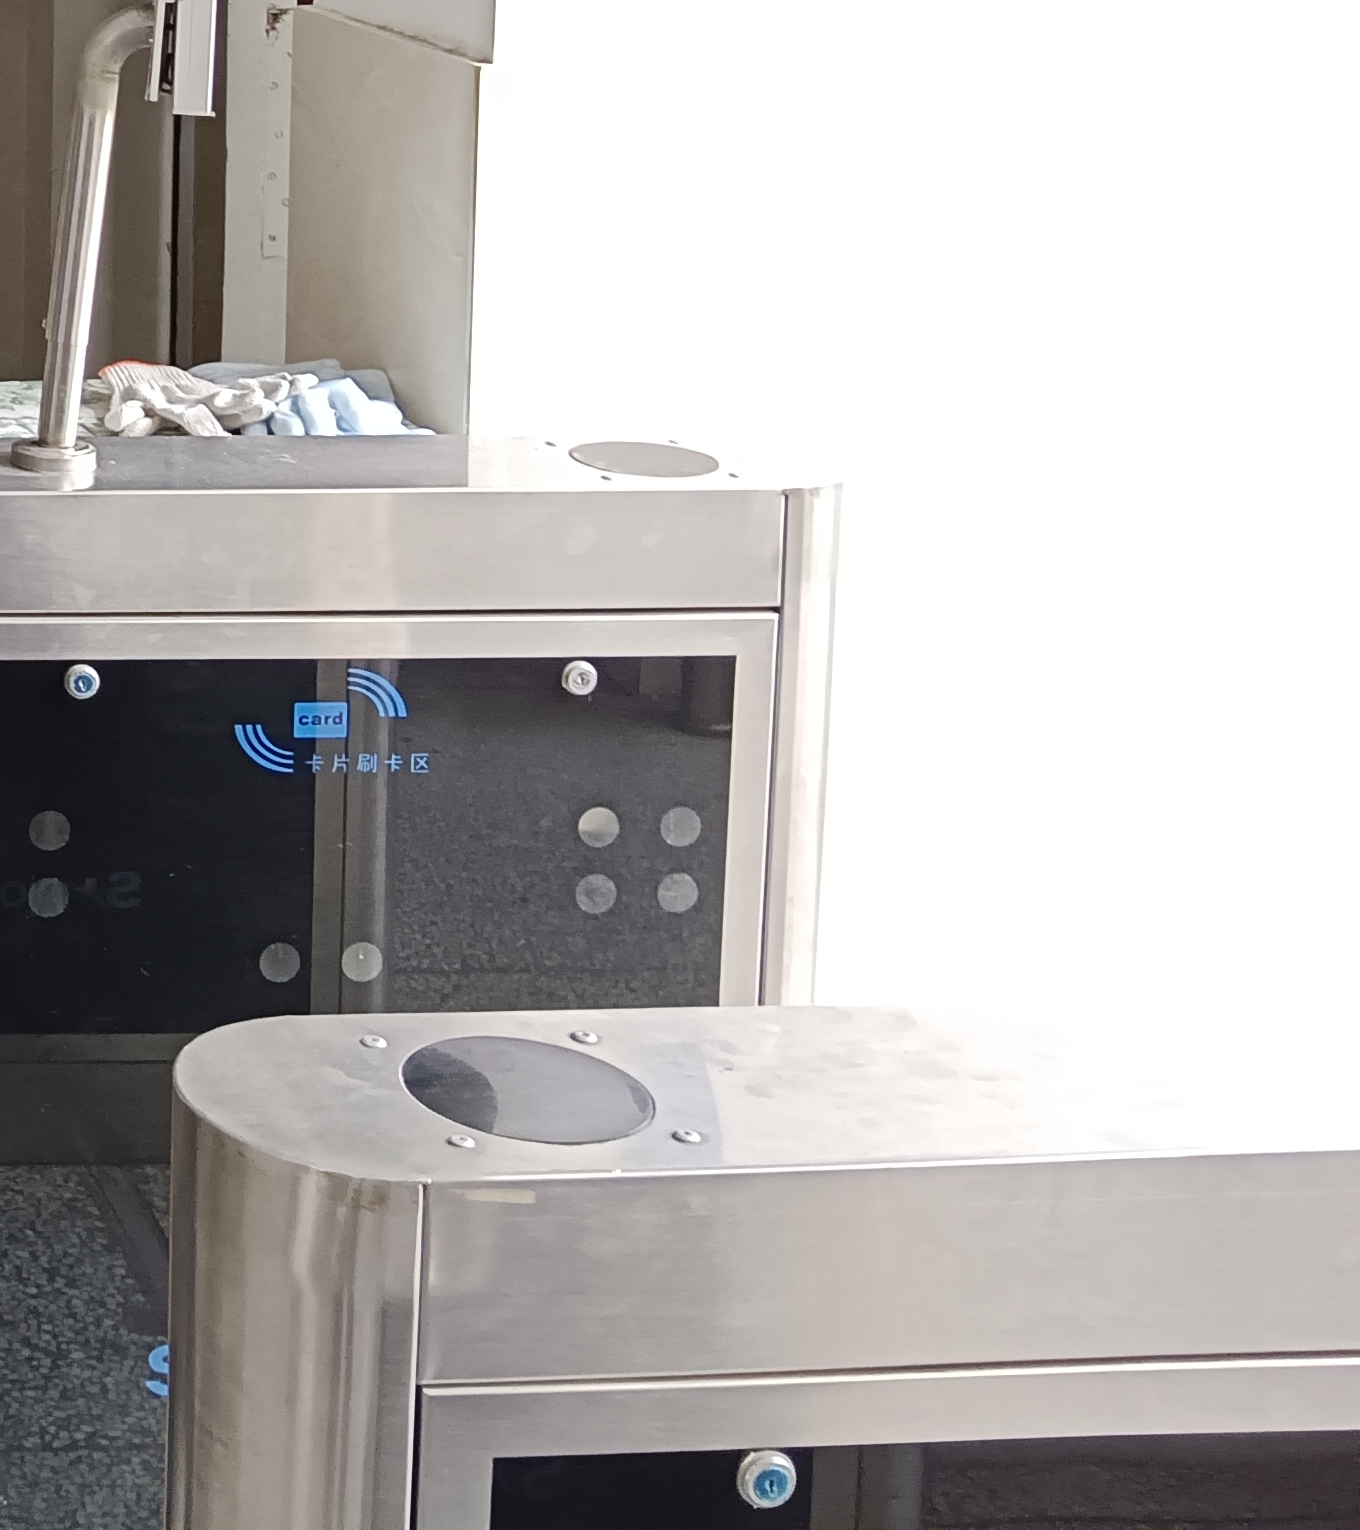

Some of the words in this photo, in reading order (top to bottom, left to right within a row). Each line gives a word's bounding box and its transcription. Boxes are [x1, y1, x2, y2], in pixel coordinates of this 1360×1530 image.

[298, 710, 343, 726] card
[304, 753, 429, 774] 卡片刷卡区
